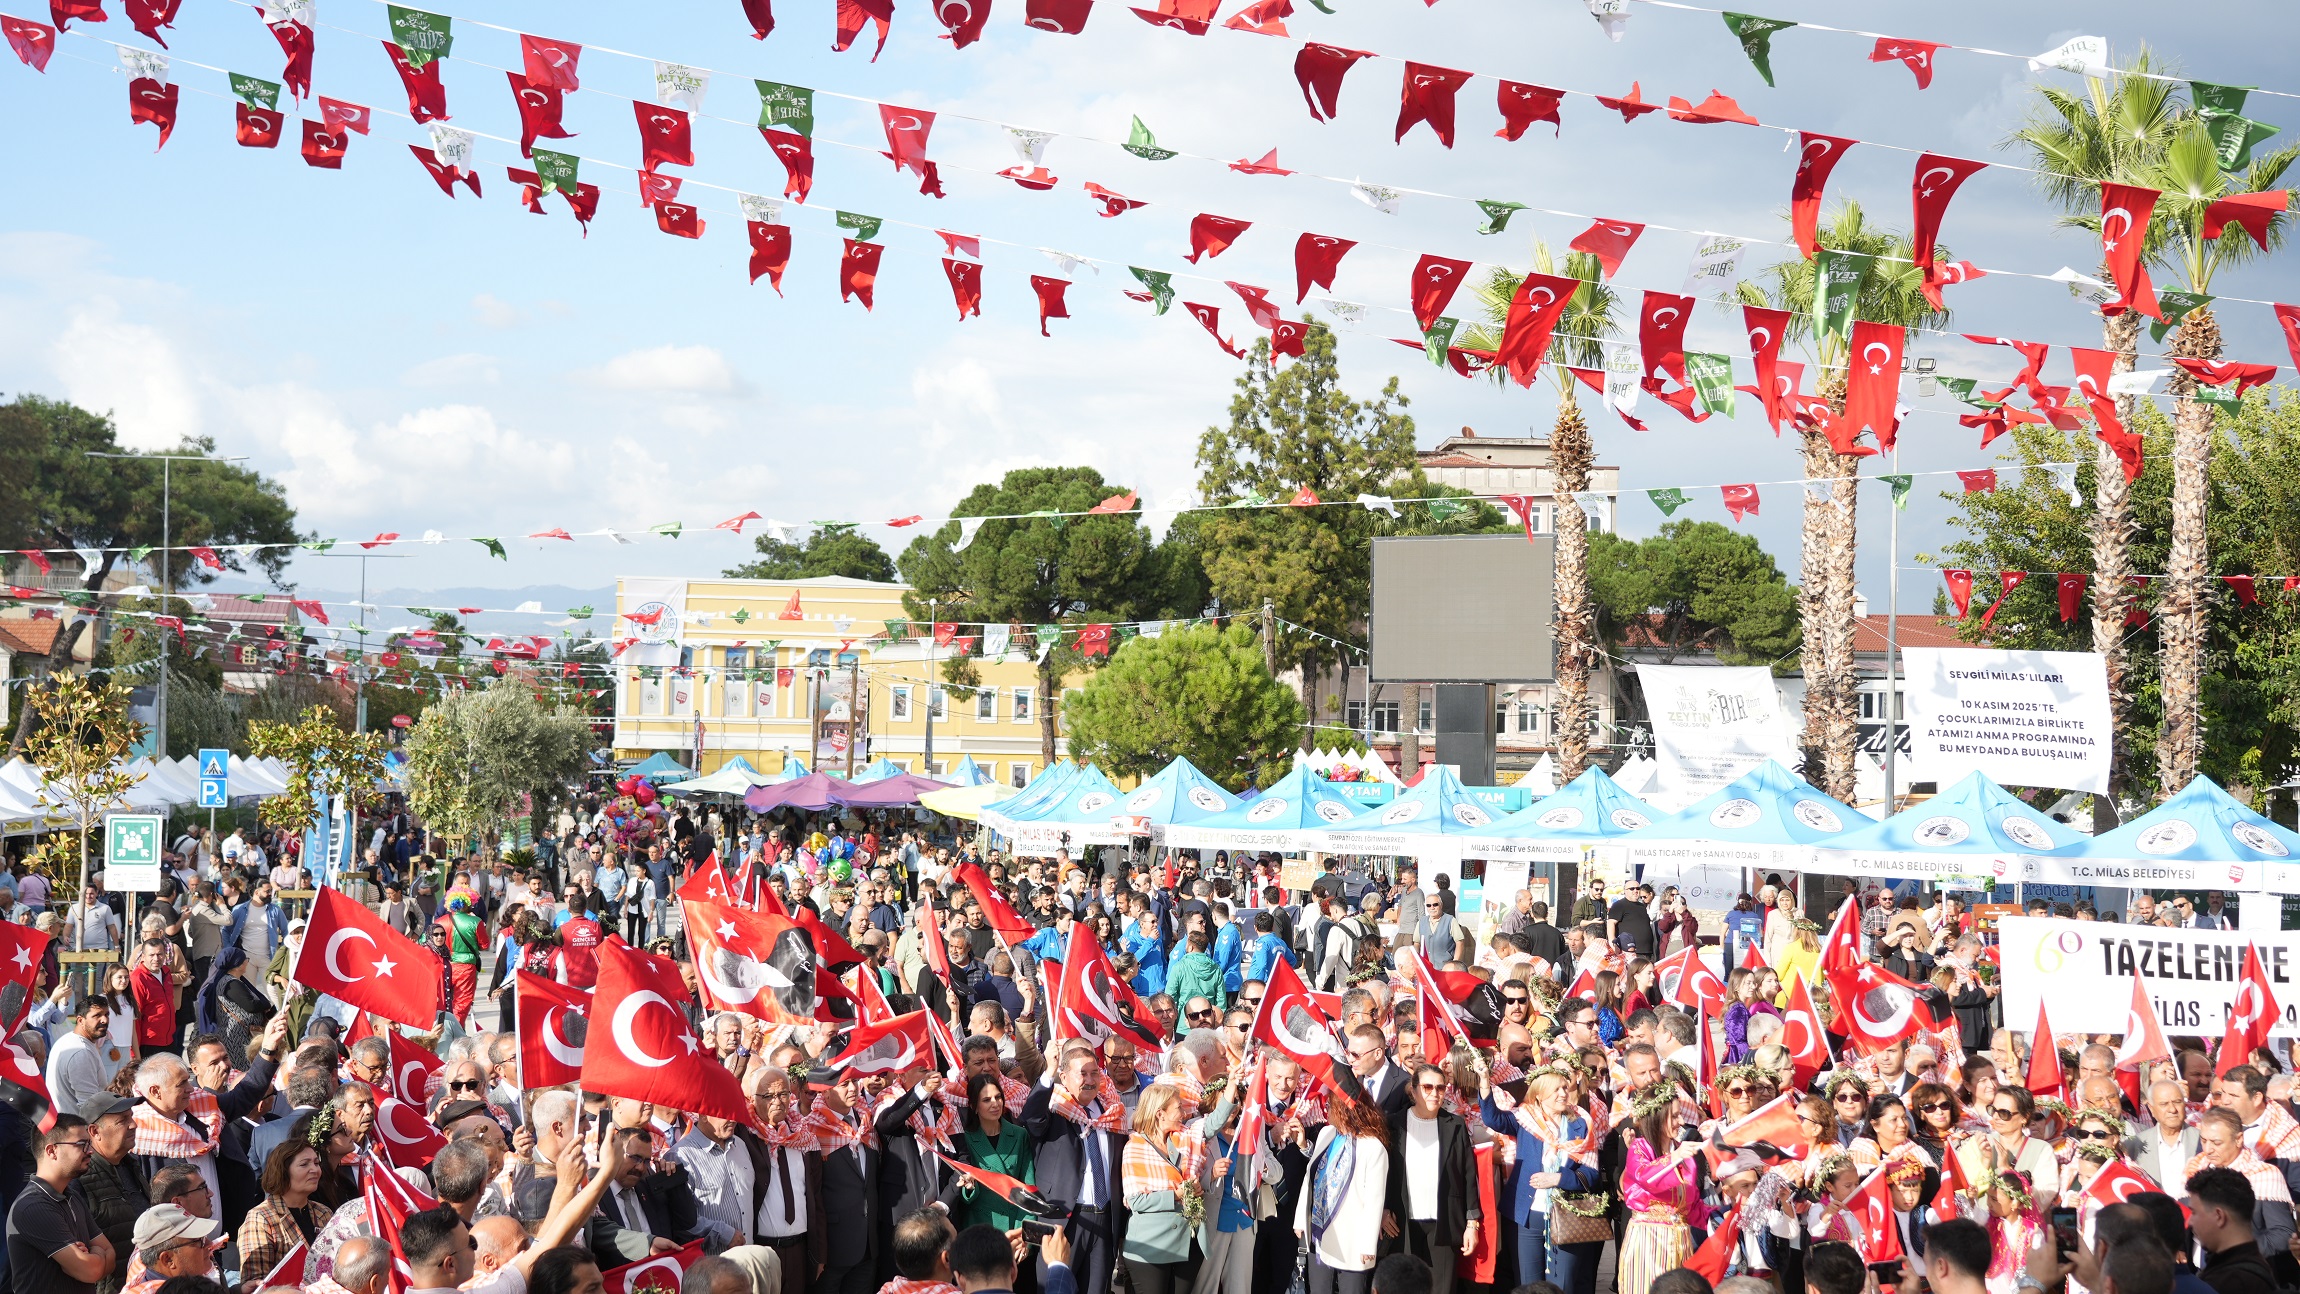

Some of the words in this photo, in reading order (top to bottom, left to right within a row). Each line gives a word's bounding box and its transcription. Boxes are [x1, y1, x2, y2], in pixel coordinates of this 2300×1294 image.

[1950, 670, 1990, 681] SEVGİLİ
[1992, 670, 2063, 683] MİLAS'LILAR!
[1961, 700, 1972, 708] 10
[1974, 701, 2009, 710] KASIM
[2012, 703, 2058, 714] 2025'TE,
[1937, 715, 2035, 727] ÇOCUKLARIMIZLA
[2037, 717, 2084, 729] BİRLİKTE
[1928, 729, 1973, 739] ATAMIZI
[1975, 731, 2009, 740] ANMA
[2012, 733, 2095, 746] PROGRAMINDA
[1939, 744, 1953, 752] BU
[1956, 745, 2019, 755] MEYDANDA
[2022, 748, 2087, 760] BULUŞALIM!
[202, 785, 218, 803] P
[1356, 786, 1381, 797] TAM
[1477, 793, 1505, 803] TAM
[1471, 843, 1489, 852] MİLAS
[1491, 843, 1516, 853] TİCARET
[1553, 846, 1573, 854] ODASI
[1634, 848, 1656, 857] MİLAS
[1658, 849, 1691, 858] TİCARET
[1703, 849, 1734, 859] SANAYİ
[1736, 851, 1760, 860] ODASI
[1852, 858, 1872, 870] T.C.
[1874, 857, 1904, 871] MİLAS
[1906, 859, 1963, 873] BELEDİYESİ
[2071, 866, 2093, 877] T.C.
[2095, 864, 2130, 878] MİLAS
[2133, 865, 2196, 880] BELEDİYESİ
[2154, 995, 2200, 1027] İLAS
